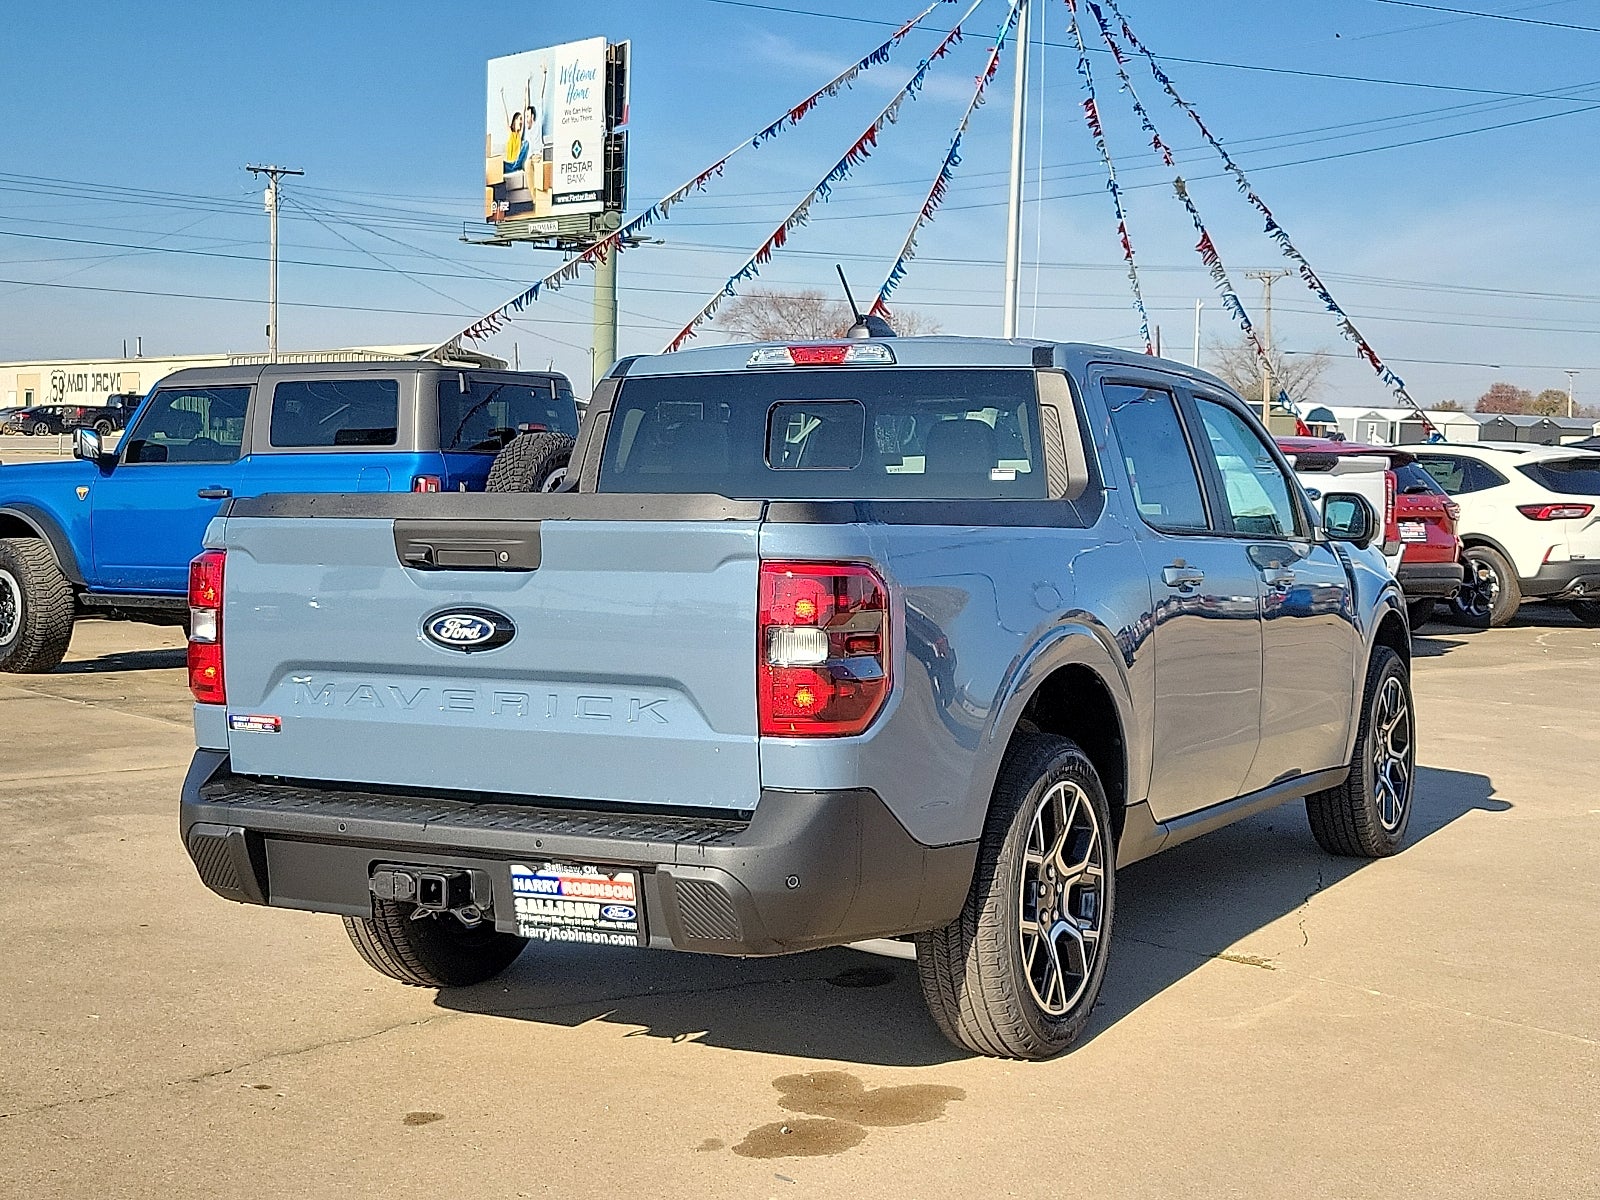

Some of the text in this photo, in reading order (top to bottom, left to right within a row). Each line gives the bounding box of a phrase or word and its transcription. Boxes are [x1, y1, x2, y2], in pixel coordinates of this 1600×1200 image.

[560, 59, 596, 85] Welcome
[566, 86, 590, 105] Home
[561, 161, 593, 174] FIRSTAR
[567, 173, 586, 185] BANK
[51, 375, 65, 402] 59
[292, 680, 669, 723] MAVERICK
[582, 865, 599, 876] OK
[513, 878, 634, 900] HARRY ROBINSON
[514, 897, 601, 919] SALLISAW
[519, 924, 638, 947] HarryRobinson.com
